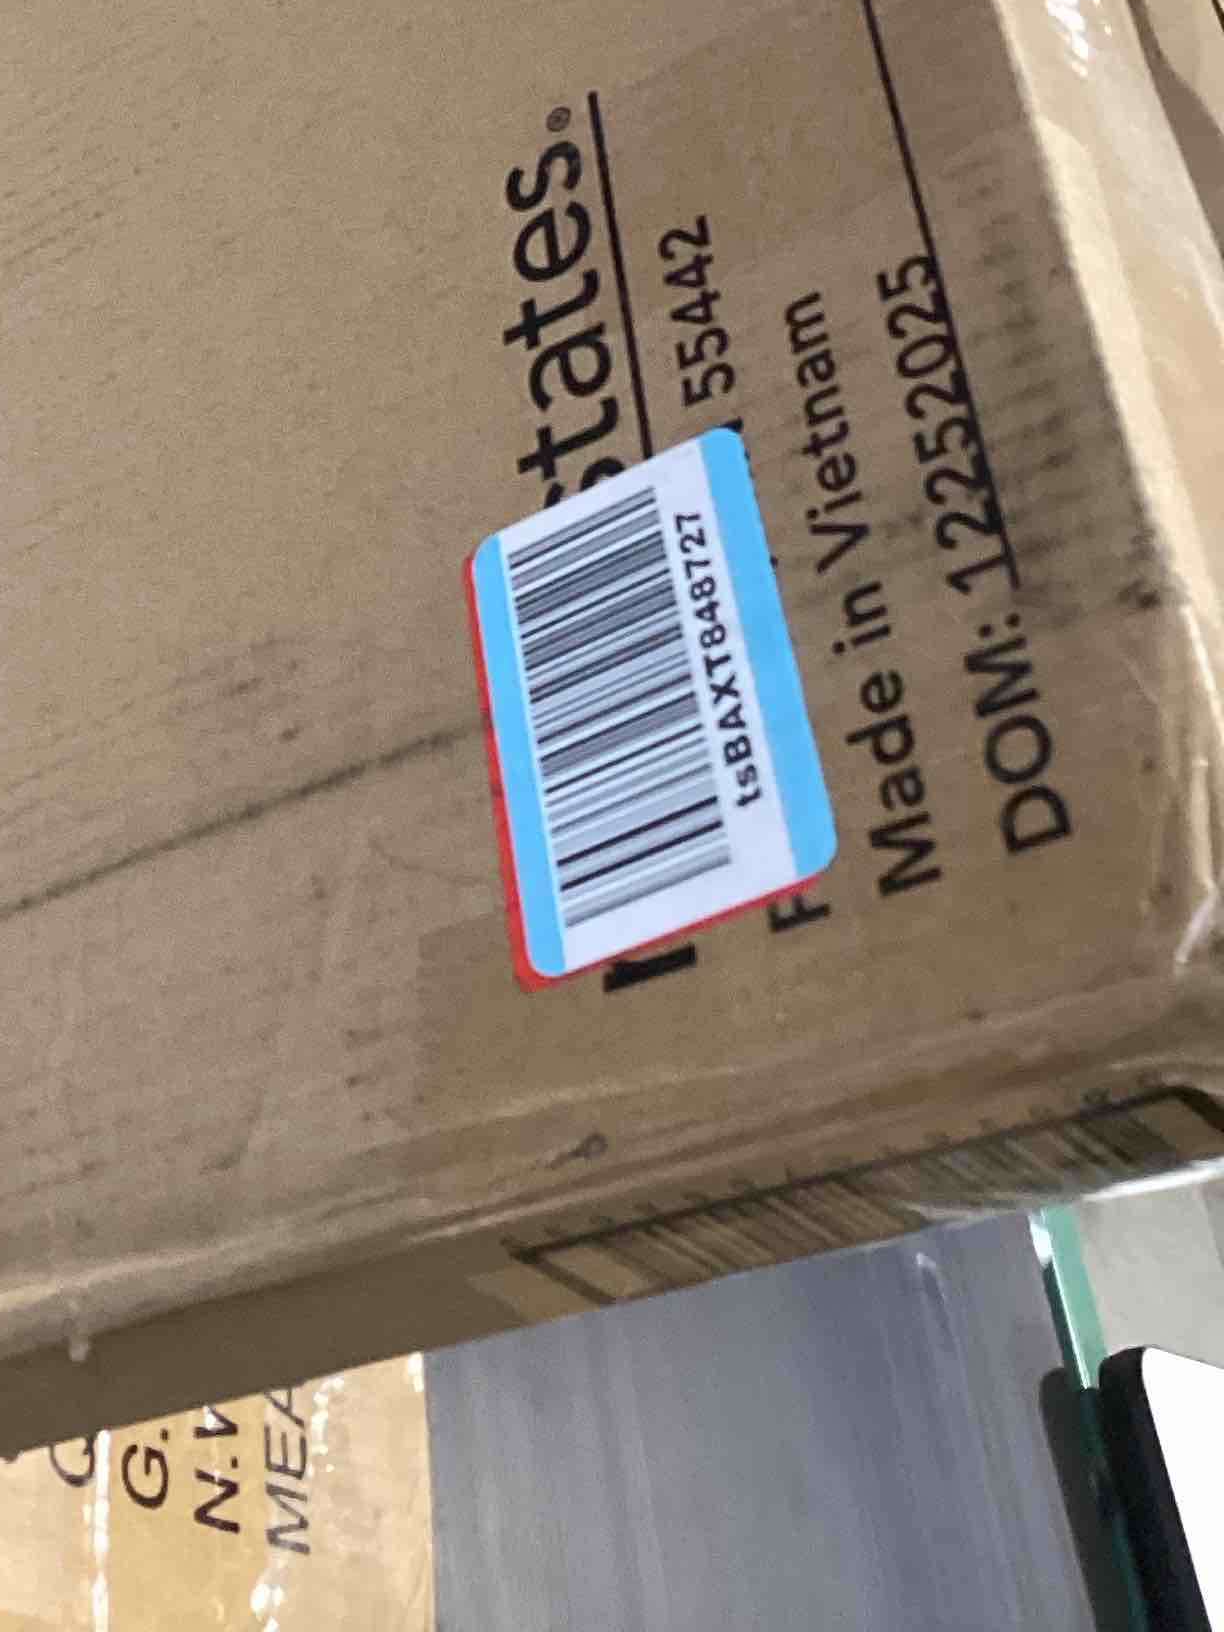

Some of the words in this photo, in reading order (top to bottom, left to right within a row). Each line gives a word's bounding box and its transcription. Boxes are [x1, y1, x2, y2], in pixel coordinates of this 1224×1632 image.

[657, 213, 736, 408] 55442
[877, 255, 1016, 595] 12252025
[785, 290, 871, 574] Vietnam
[833, 581, 892, 656] in
[964, 612, 1072, 854] DOM:
[846, 669, 942, 898] Made
